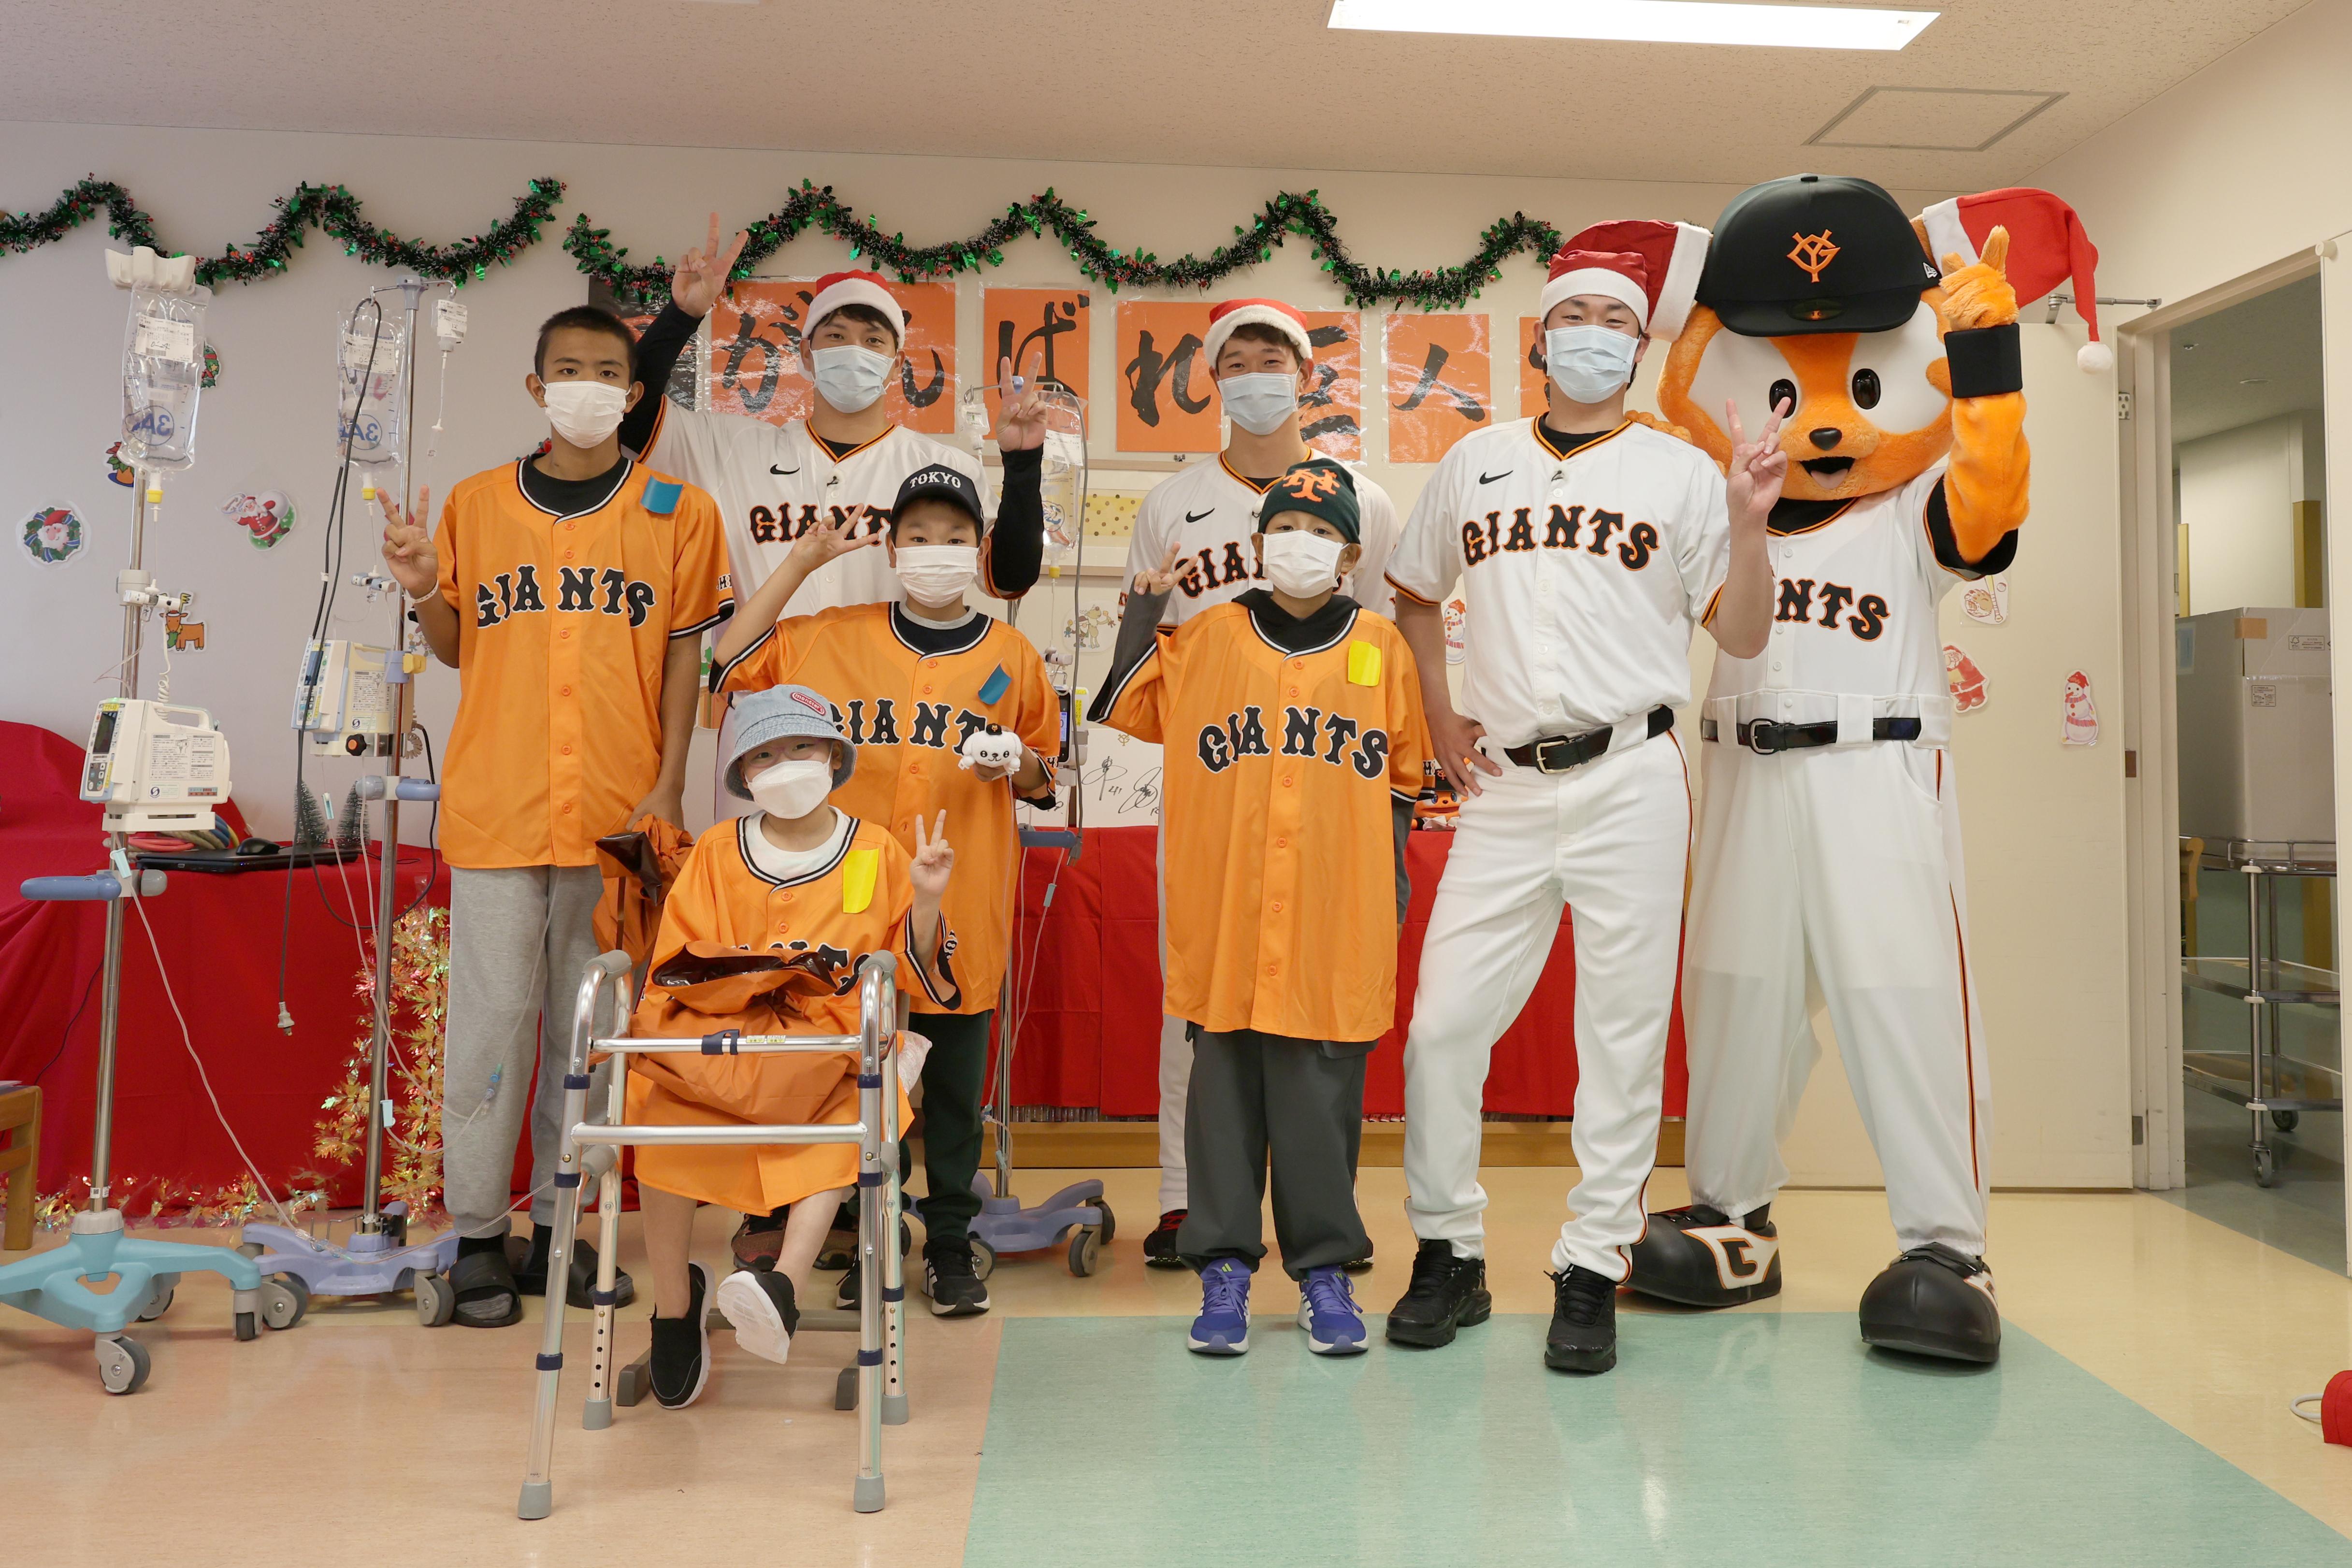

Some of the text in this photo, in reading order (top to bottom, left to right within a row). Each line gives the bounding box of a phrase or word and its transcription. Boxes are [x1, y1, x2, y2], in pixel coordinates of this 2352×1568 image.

[909, 471, 962, 489] TOKYO
[750, 502, 891, 546] GIANT
[1462, 503, 1659, 571] GIANTS
[476, 563, 656, 628] GIANTS
[794, 693, 823, 713] monster's
[1198, 705, 1389, 780] GIANTS
